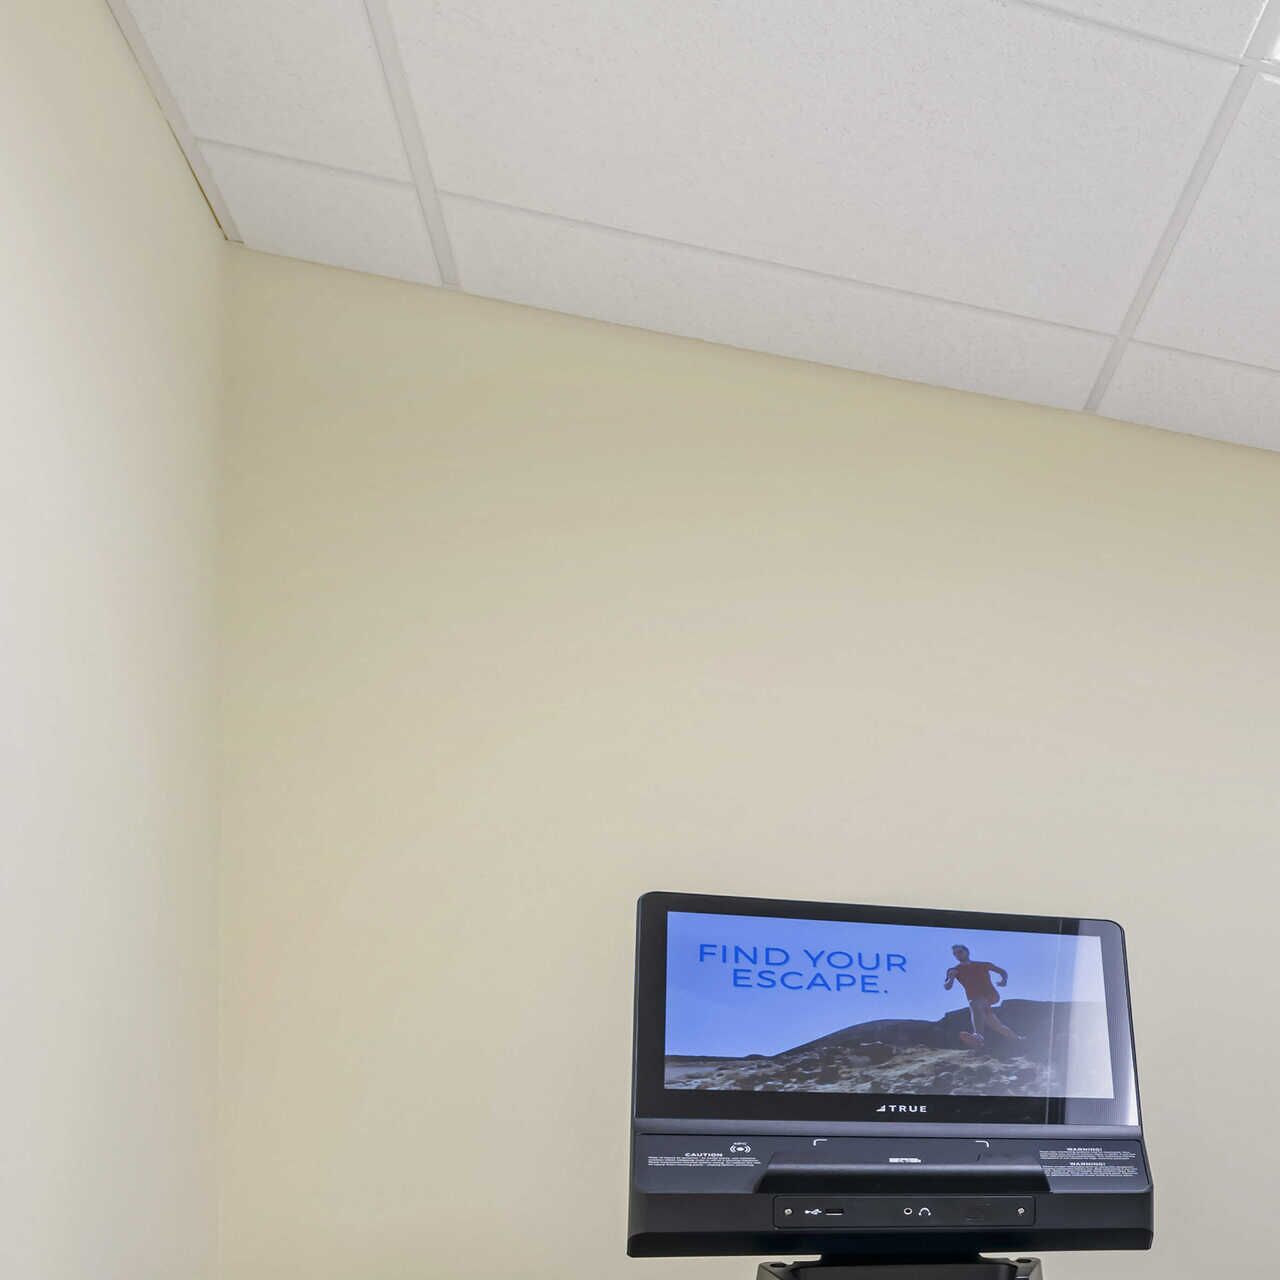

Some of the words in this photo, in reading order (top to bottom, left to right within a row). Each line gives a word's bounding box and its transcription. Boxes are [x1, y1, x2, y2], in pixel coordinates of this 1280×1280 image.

[699, 943, 790, 966] FIND
[803, 949, 907, 973] YOUR
[732, 968, 888, 994] ESCAPE.
[888, 1105, 927, 1113] TRUE
